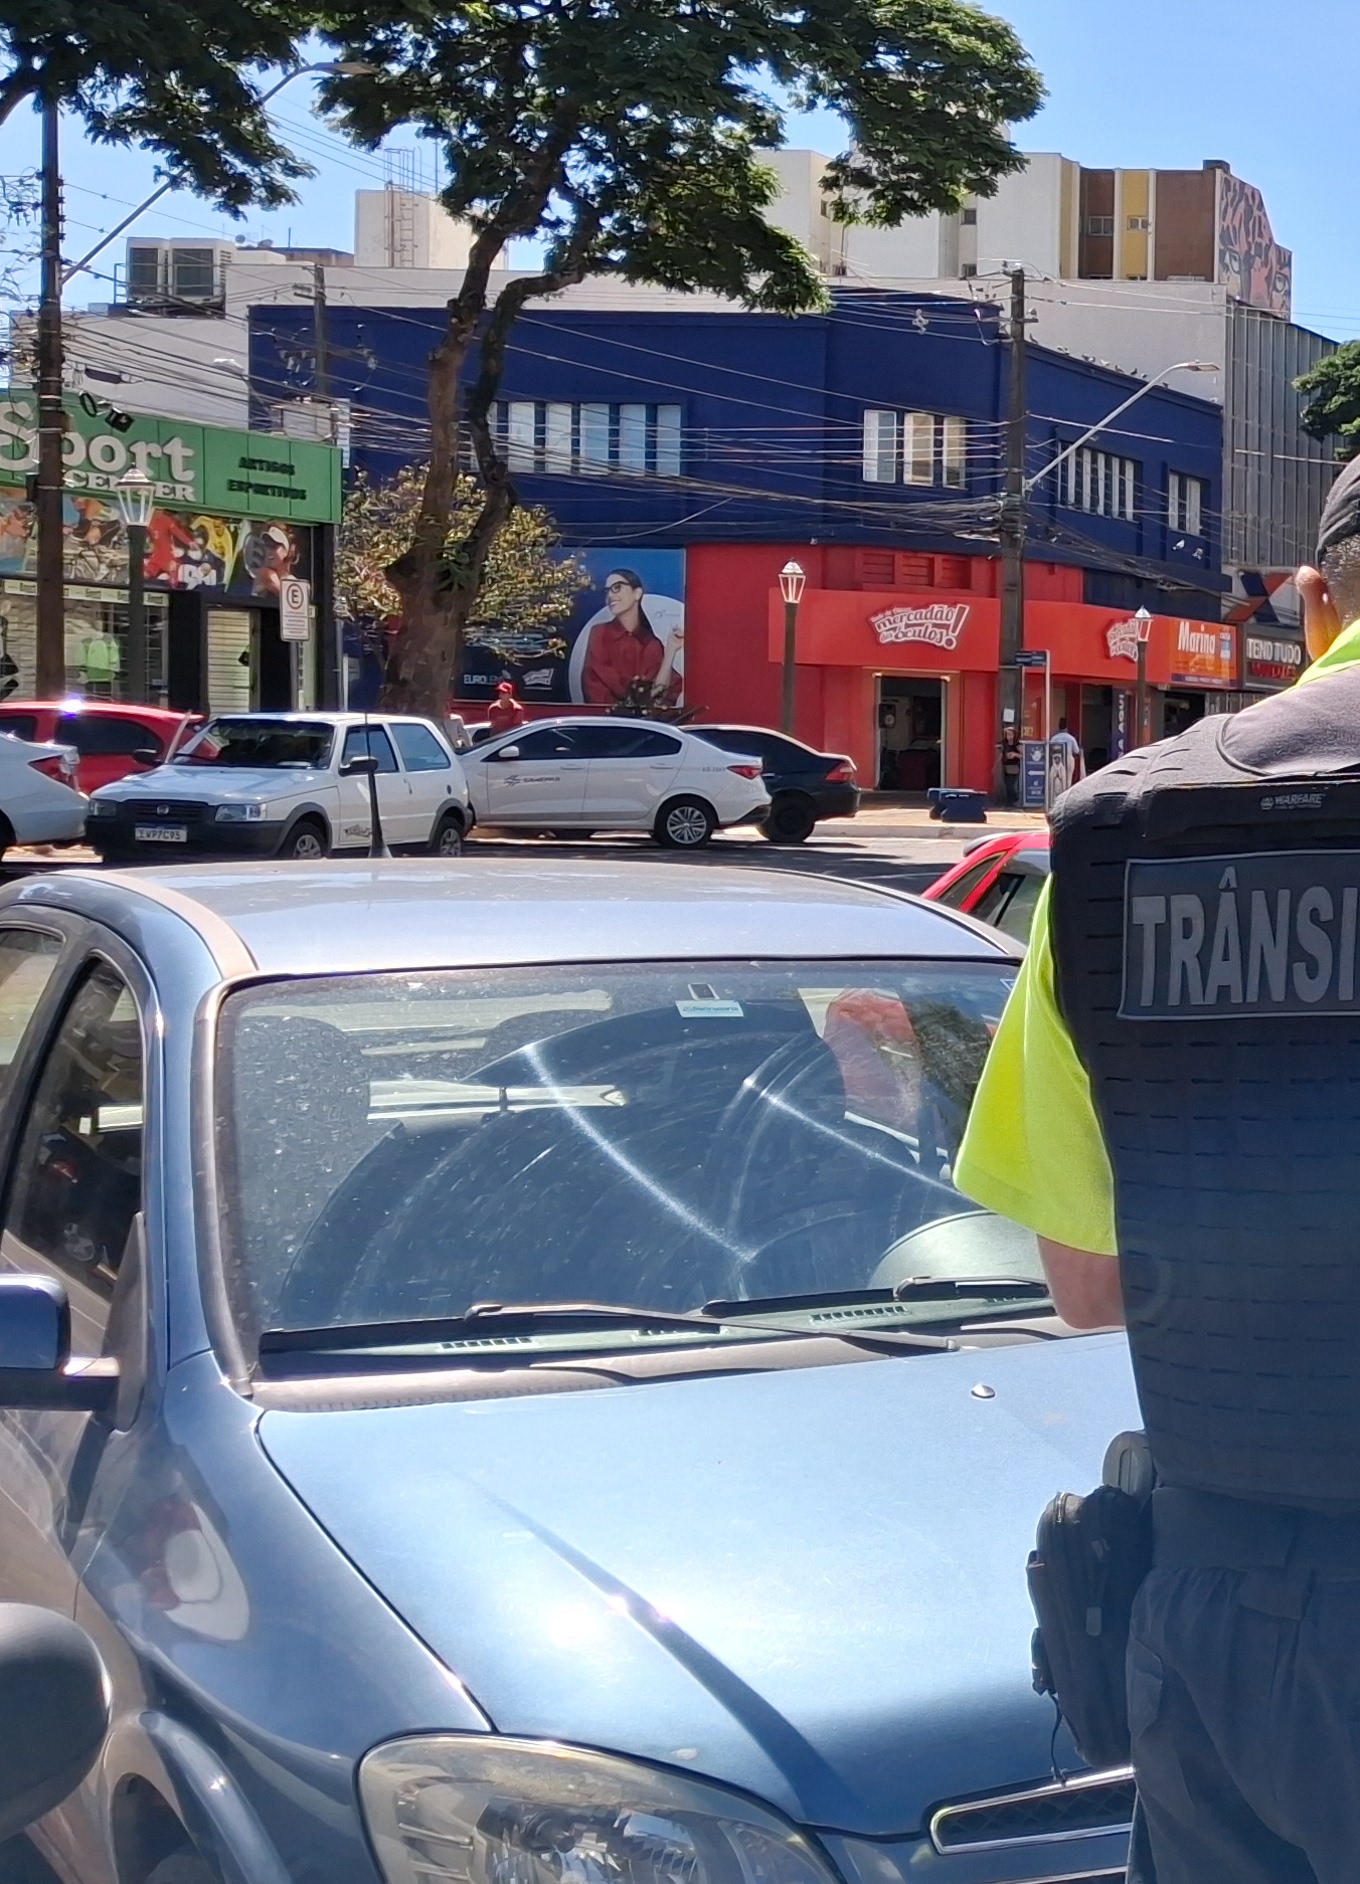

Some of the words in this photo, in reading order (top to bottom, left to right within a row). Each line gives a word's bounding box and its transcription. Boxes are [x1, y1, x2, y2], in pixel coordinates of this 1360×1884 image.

[64, 470, 196, 502] CEER
[1178, 620, 1216, 655] Marina
[1273, 641, 1302, 666] TUDO
